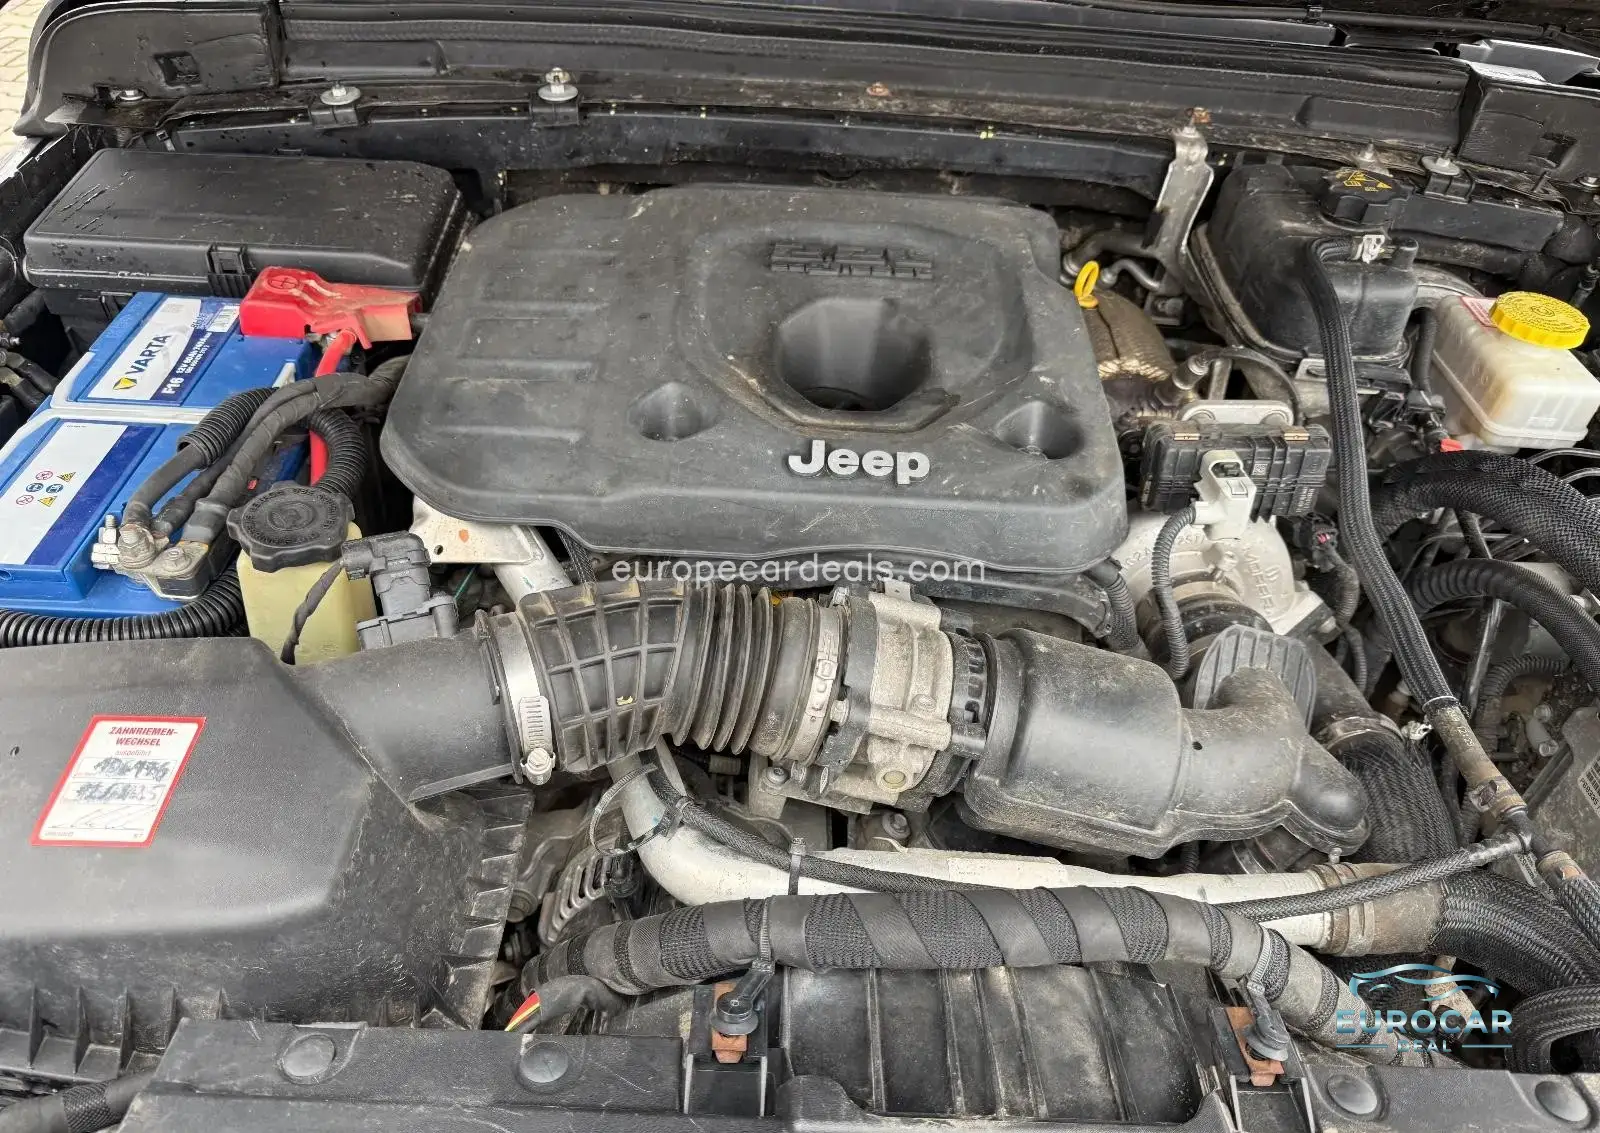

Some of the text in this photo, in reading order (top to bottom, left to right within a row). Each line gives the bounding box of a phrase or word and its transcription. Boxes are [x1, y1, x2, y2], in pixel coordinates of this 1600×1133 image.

[125, 334, 172, 376] VARTA
[161, 377, 185, 395] F16
[788, 439, 931, 485] Jeep
[109, 726, 178, 736] ZAHNRIEMEN-
[115, 737, 161, 747] WECHSEL
